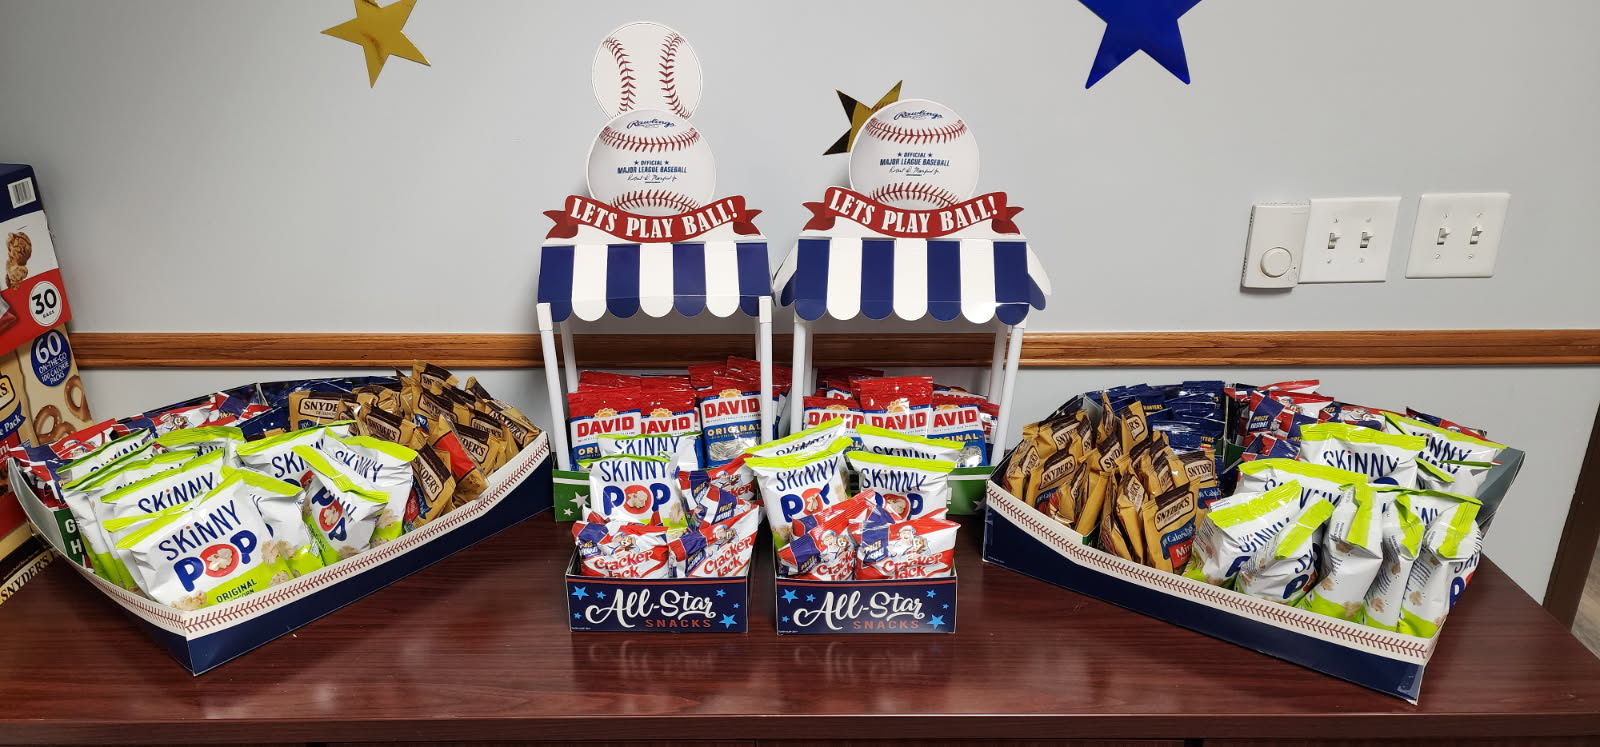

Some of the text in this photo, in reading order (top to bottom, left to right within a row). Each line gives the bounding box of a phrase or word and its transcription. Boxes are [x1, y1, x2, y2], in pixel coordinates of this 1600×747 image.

[617, 166, 637, 174] MAJOR
[880, 158, 950, 167] MAJOR LEAGUE BASEBALL
[570, 197, 738, 239] LETS PLAY BALL!
[828, 189, 999, 233] LETS PLAY BALL!
[32, 288, 57, 315] 30
[35, 331, 62, 364] 60
[703, 397, 761, 419] DAVID
[933, 409, 978, 428] AVID
[1253, 414, 1269, 422] PRIZE
[4, 415, 21, 432] Pack
[577, 415, 635, 438] DAVID
[871, 411, 927, 430] DAVID
[602, 482, 671, 516] POP
[173, 529, 257, 592] POP
[593, 550, 654, 570] Cracker
[703, 535, 754, 575] Cracker
[881, 552, 944, 573] Cracker
[215, 578, 258, 603] ORIGINAL
[585, 588, 717, 629] All-Star
[793, 590, 925, 630] All-Star
[645, 619, 712, 628] SNACKS
[853, 620, 920, 629] SNACKS
